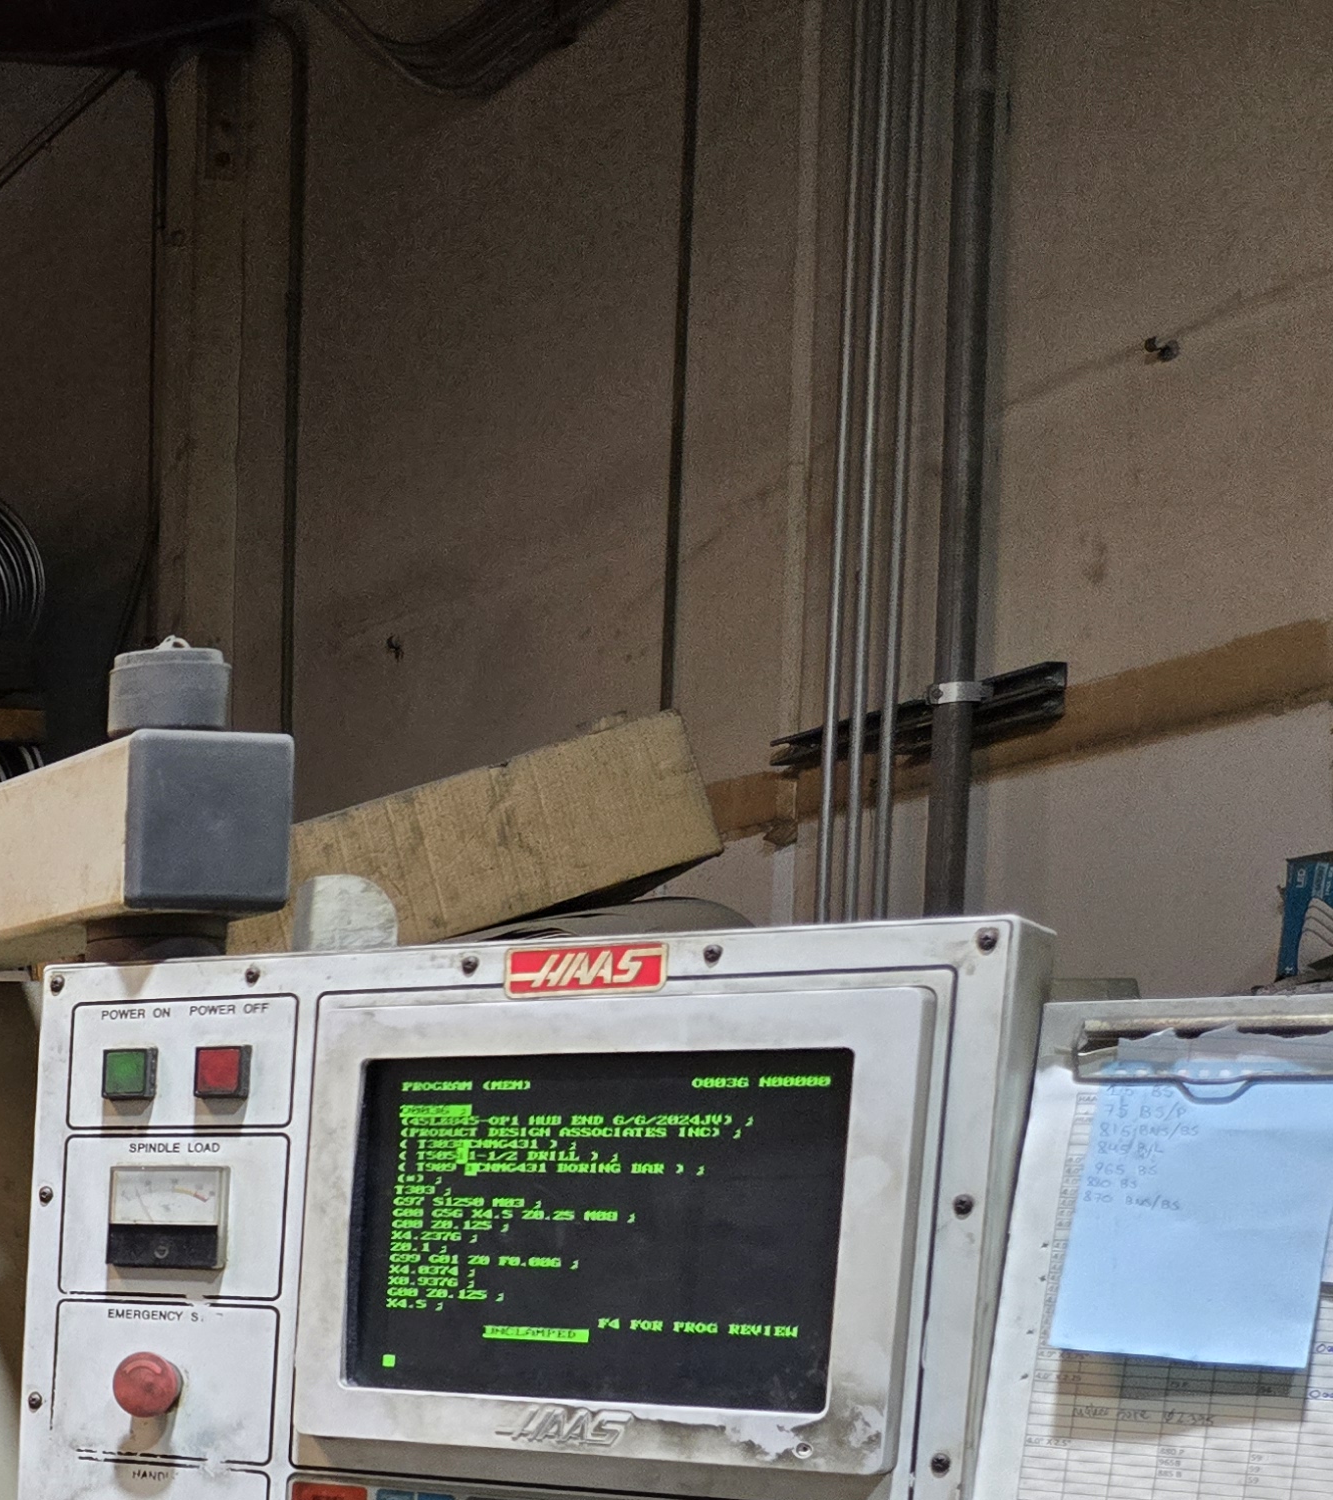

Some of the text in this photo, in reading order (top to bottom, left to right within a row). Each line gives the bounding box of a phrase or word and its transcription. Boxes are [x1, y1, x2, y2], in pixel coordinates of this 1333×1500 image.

[511, 947, 663, 988] HAAS
[101, 1008, 171, 1020] POWER ON
[189, 1003, 270, 1016] POWER OFF
[401, 1080, 531, 1092] PROGRAM (MEM)
[758, 1076, 831, 1088] N00000
[528, 1115, 562, 1126] HUB
[571, 1115, 604, 1126] END
[400, 1127, 721, 1138] (PRODUCT DESIGN ASSOCIATES INC)
[129, 1143, 220, 1154] SPINDLE LOAD
[526, 1151, 580, 1162] DRILL
[556, 1163, 622, 1174] BORING
[631, 1163, 665, 1174] BAR
[394, 1185, 436, 1195] T303
[393, 1196, 425, 1207] G97
[432, 1197, 484, 1207] S1250
[521, 1210, 575, 1221] Z0.25
[430, 1219, 493, 1230] Z0.125
[390, 1231, 462, 1241] X4.2376
[389, 1242, 430, 1252] Z0.1
[389, 1253, 421, 1264] G99
[428, 1254, 459, 1264] G01
[426, 1288, 488, 1300] Z0.125
[107, 1308, 183, 1321] EMERGENCY
[597, 1317, 800, 1338] F4 FOR PROG REVIEW
[495, 1405, 633, 1448] HAAS
